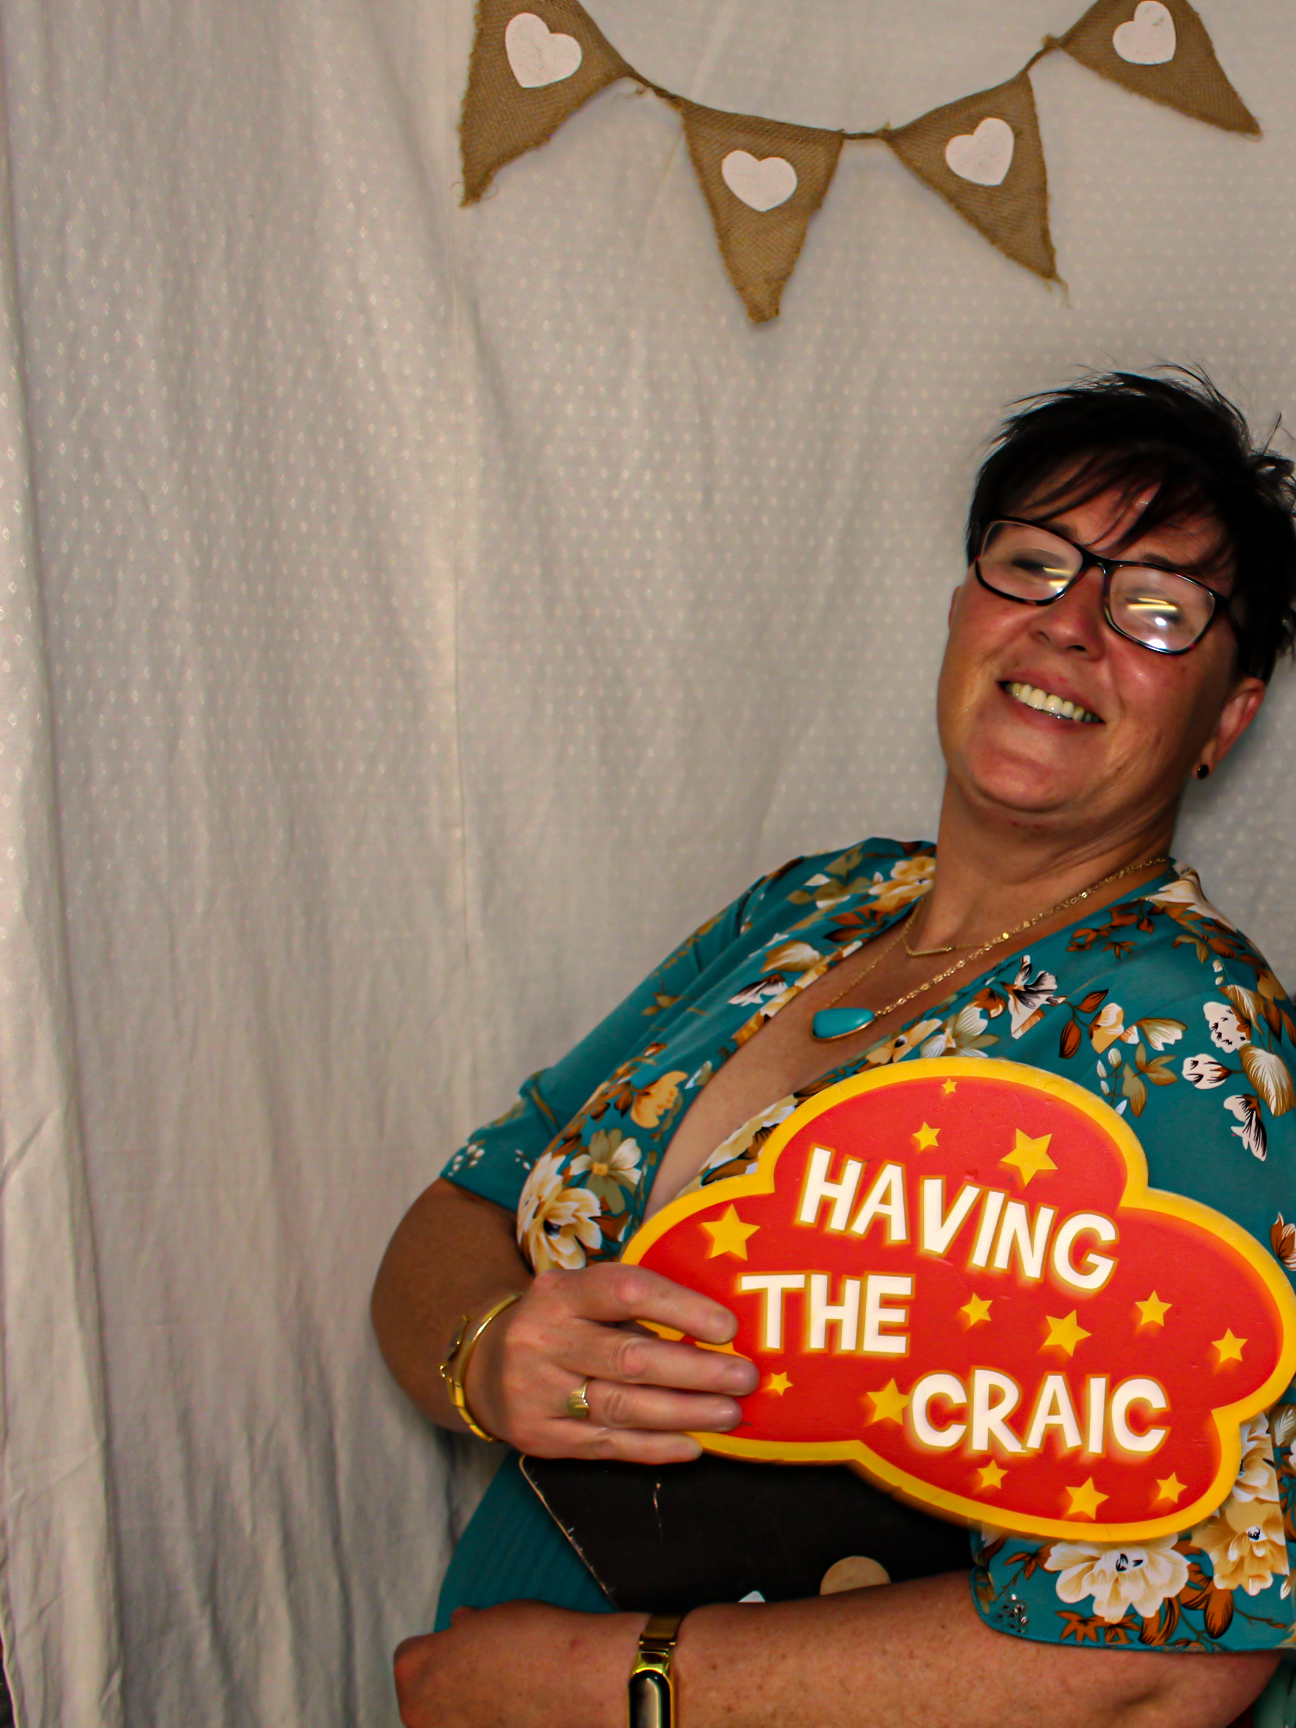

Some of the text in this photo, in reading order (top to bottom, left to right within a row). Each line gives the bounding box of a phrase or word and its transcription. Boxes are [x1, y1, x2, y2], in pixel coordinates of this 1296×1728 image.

[798, 1147, 1116, 1290] HAVING
[740, 1273, 912, 1354] THE
[911, 1369, 1168, 1453] CRAIC
